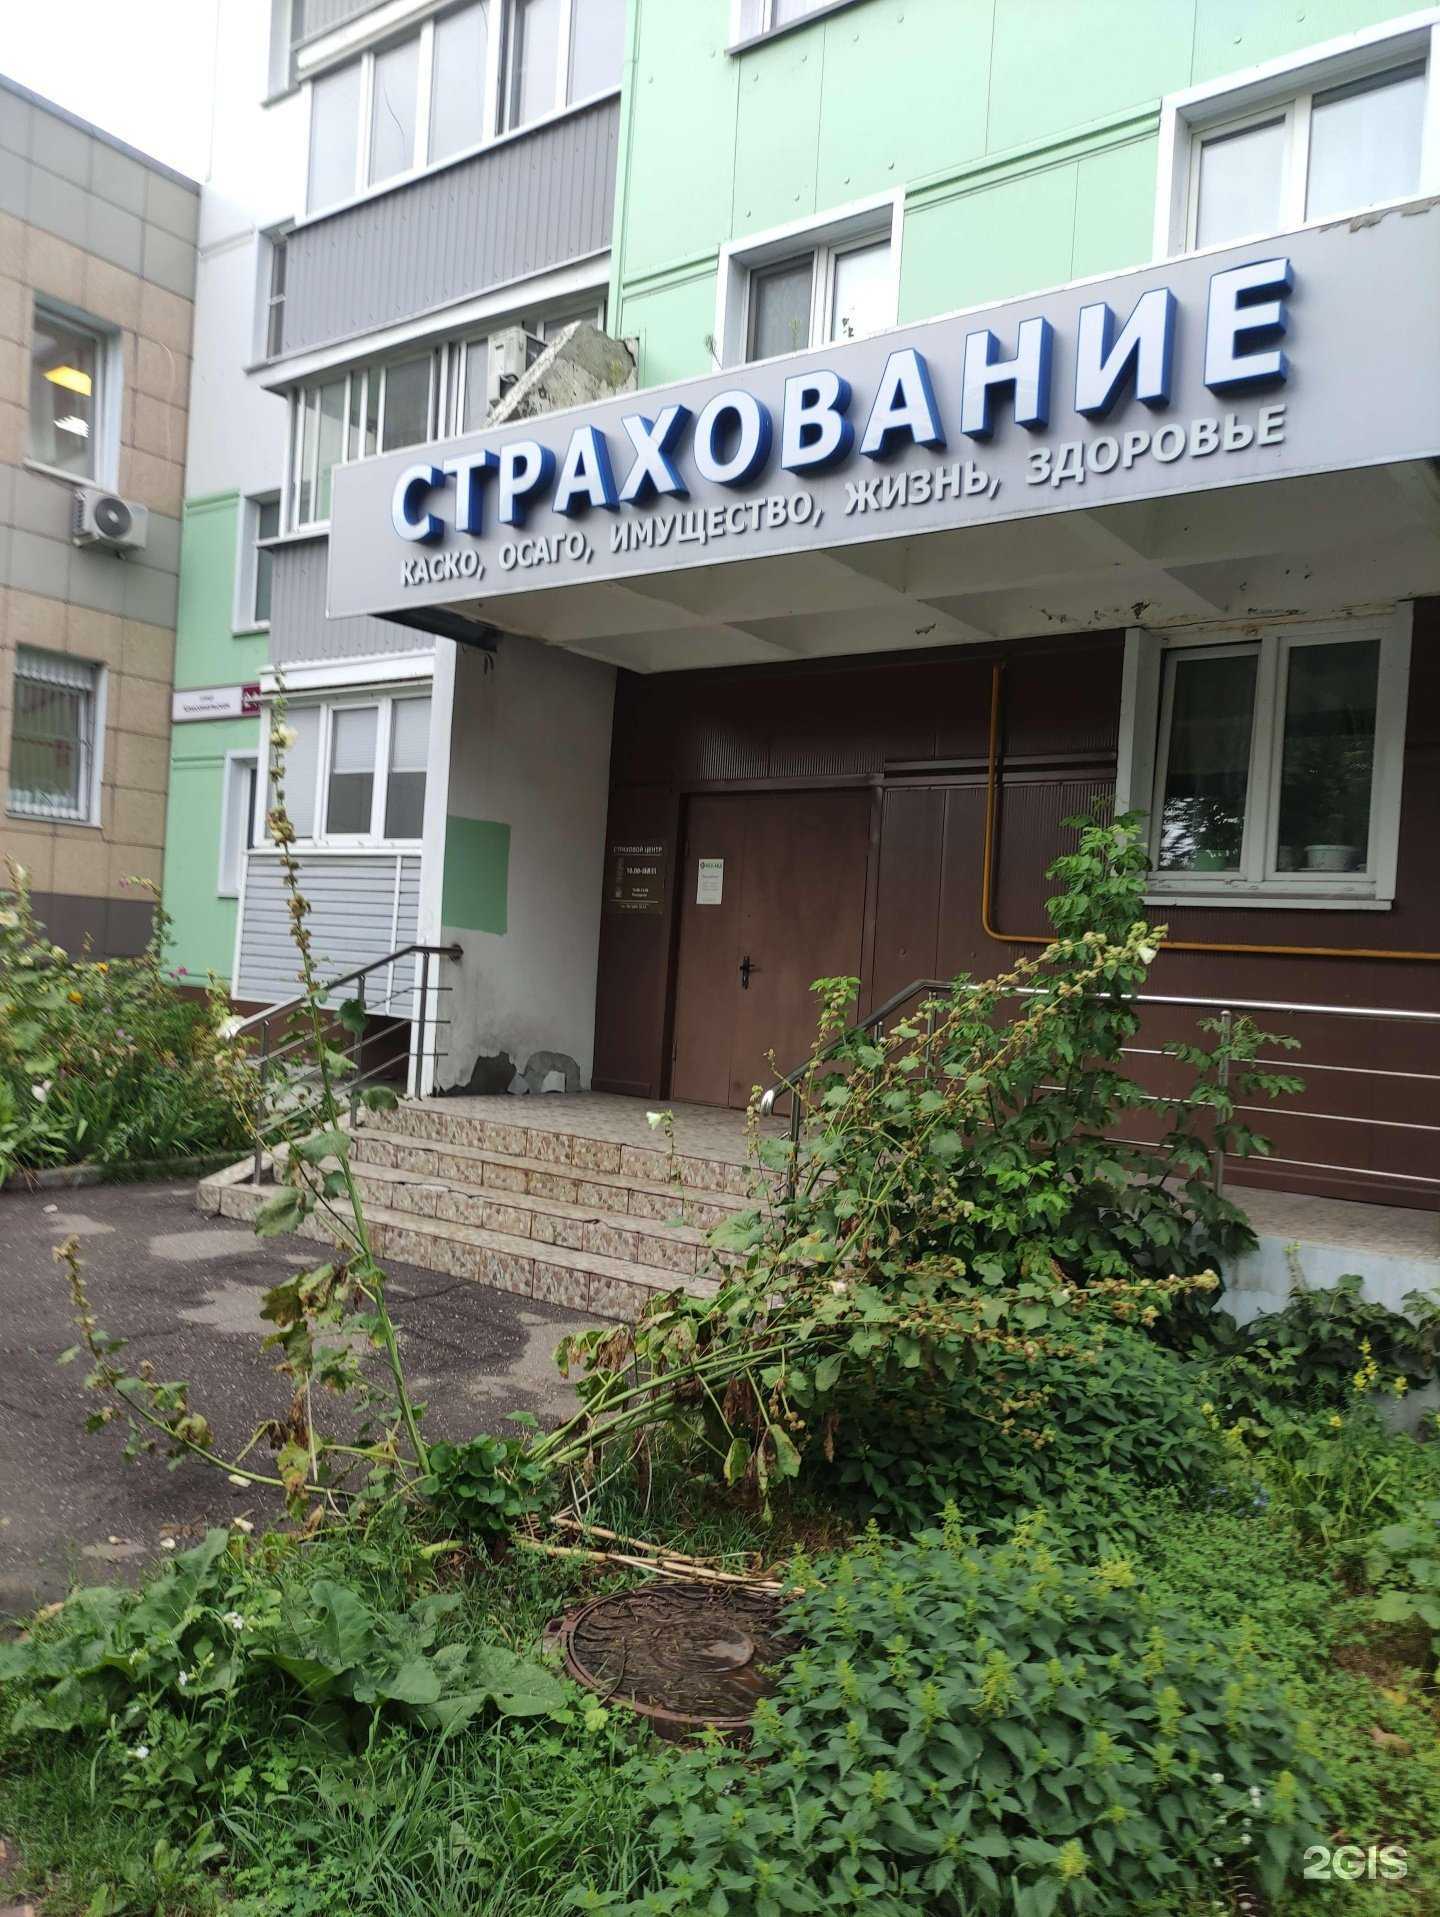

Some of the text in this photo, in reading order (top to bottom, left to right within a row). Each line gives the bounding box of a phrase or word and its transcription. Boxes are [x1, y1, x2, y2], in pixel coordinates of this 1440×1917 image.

[391, 257, 1294, 544] СТРАХОВАНИЕ
[399, 403, 1287, 587] КАСКО, ОСАГО, ИМУЩЕСТВО, ЖИЗНЬ, ЗДОРОВЬЕ
